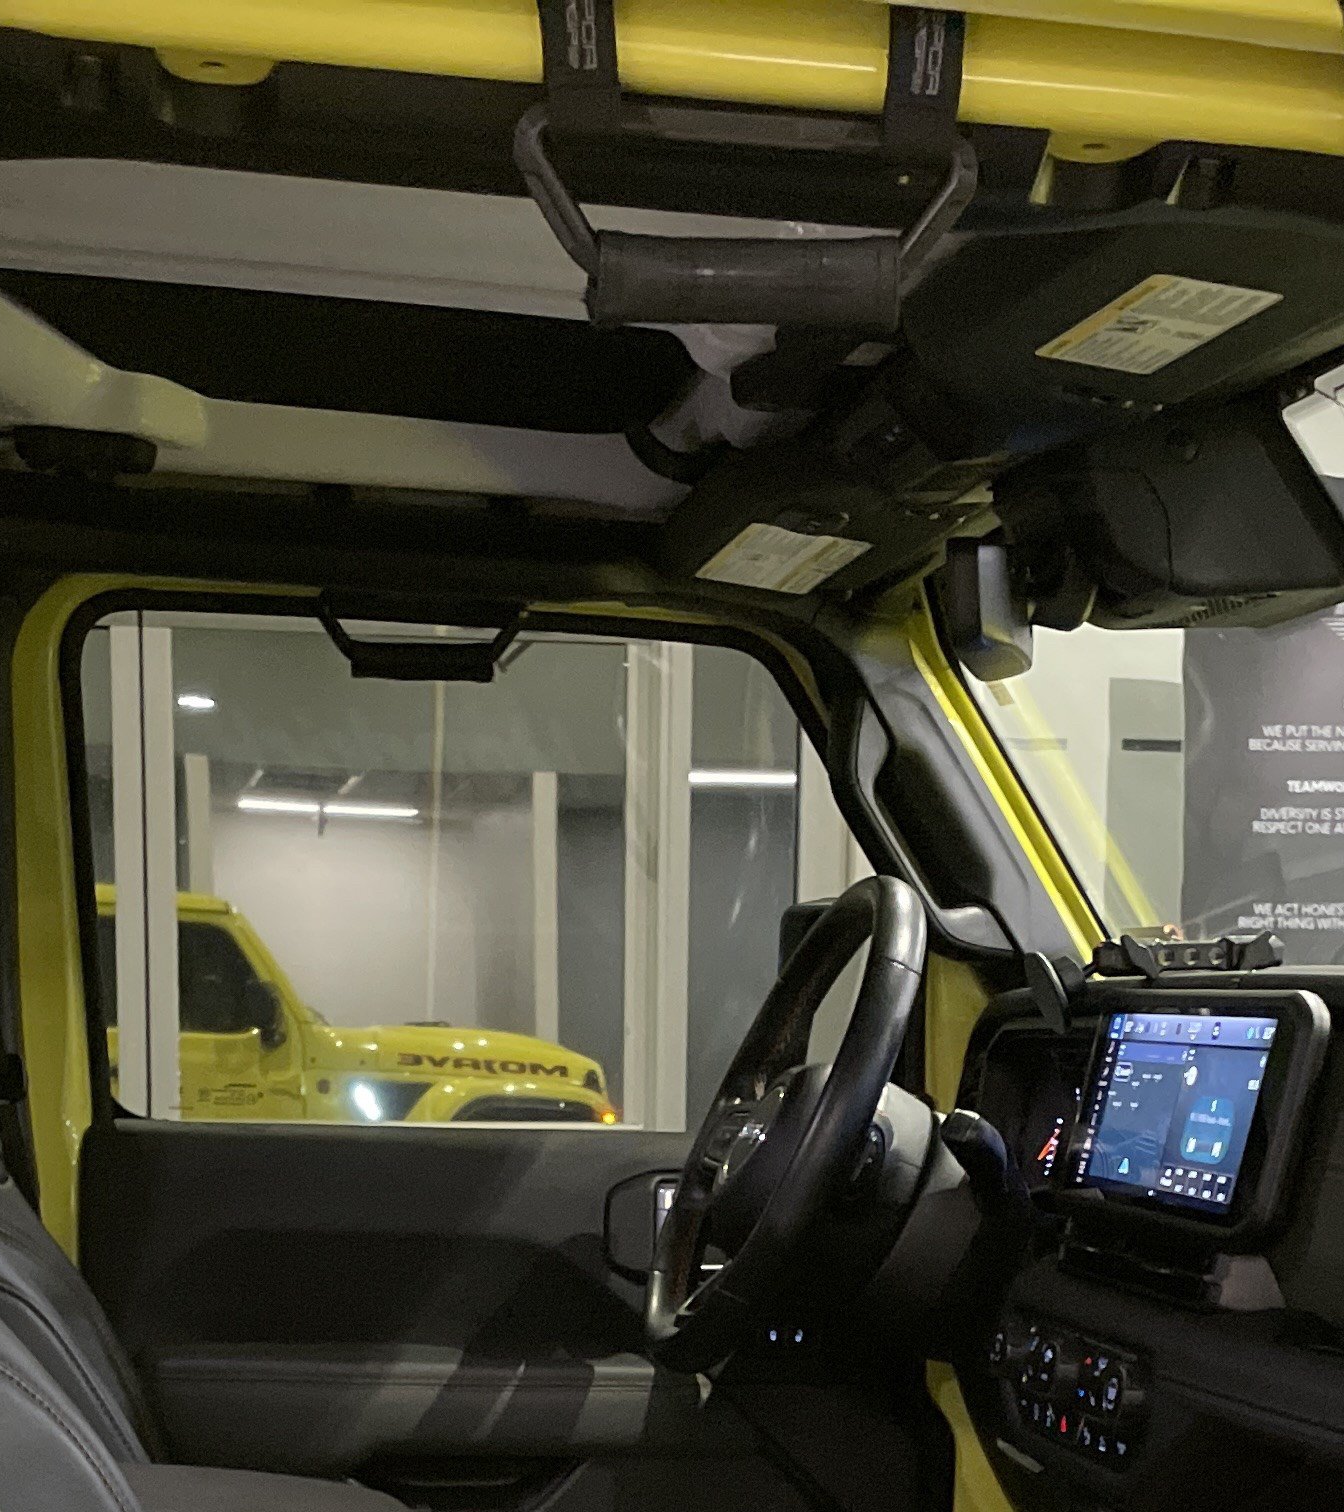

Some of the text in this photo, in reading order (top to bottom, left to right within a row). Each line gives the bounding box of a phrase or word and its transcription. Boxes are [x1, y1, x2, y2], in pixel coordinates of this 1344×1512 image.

[1262, 724, 1283, 738] WE
[1285, 724, 1308, 738] PUT
[1310, 725, 1333, 738] THE
[1248, 738, 1303, 751] BECAUSE
[1260, 807, 1319, 820] DIVERSITY
[1320, 807, 1333, 820] IS
[1252, 820, 1303, 834] RESPECT
[1305, 821, 1331, 835] ONE
[1253, 902, 1273, 915] WE
[1274, 902, 1299, 916] ACT
[1237, 916, 1275, 929] RIGHT
[1276, 916, 1315, 930] THING
